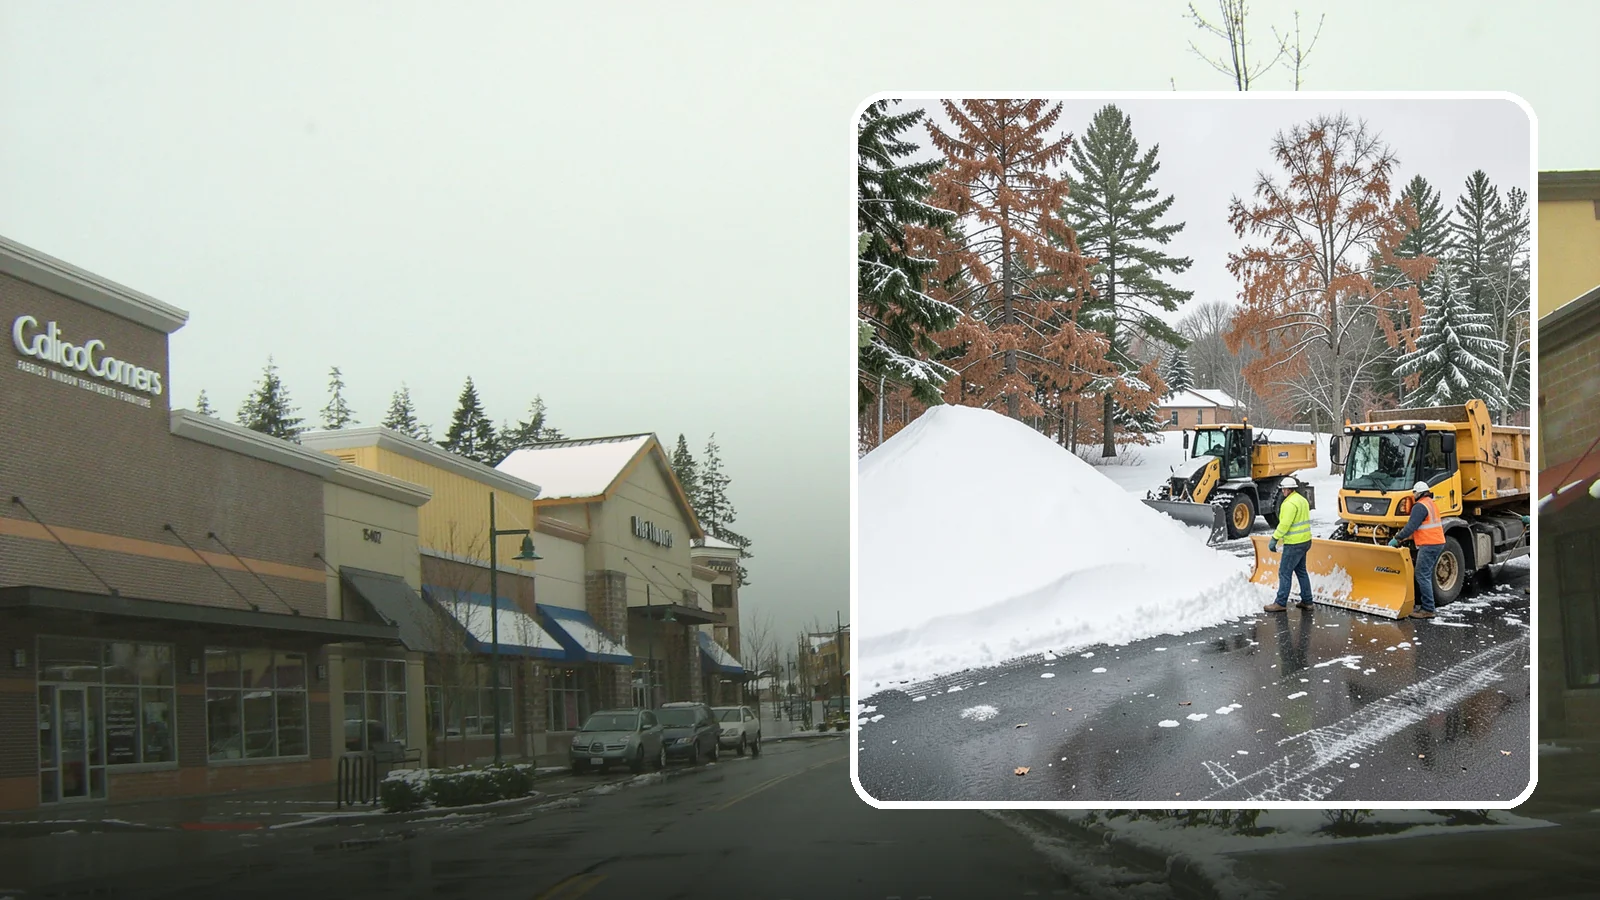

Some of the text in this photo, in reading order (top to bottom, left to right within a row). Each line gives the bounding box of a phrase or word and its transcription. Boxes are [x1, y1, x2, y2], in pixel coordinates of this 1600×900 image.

[17, 359, 47, 378] FABRICS
[51, 370, 78, 387] WINDOW
[78, 378, 117, 398] TREATMENTS
